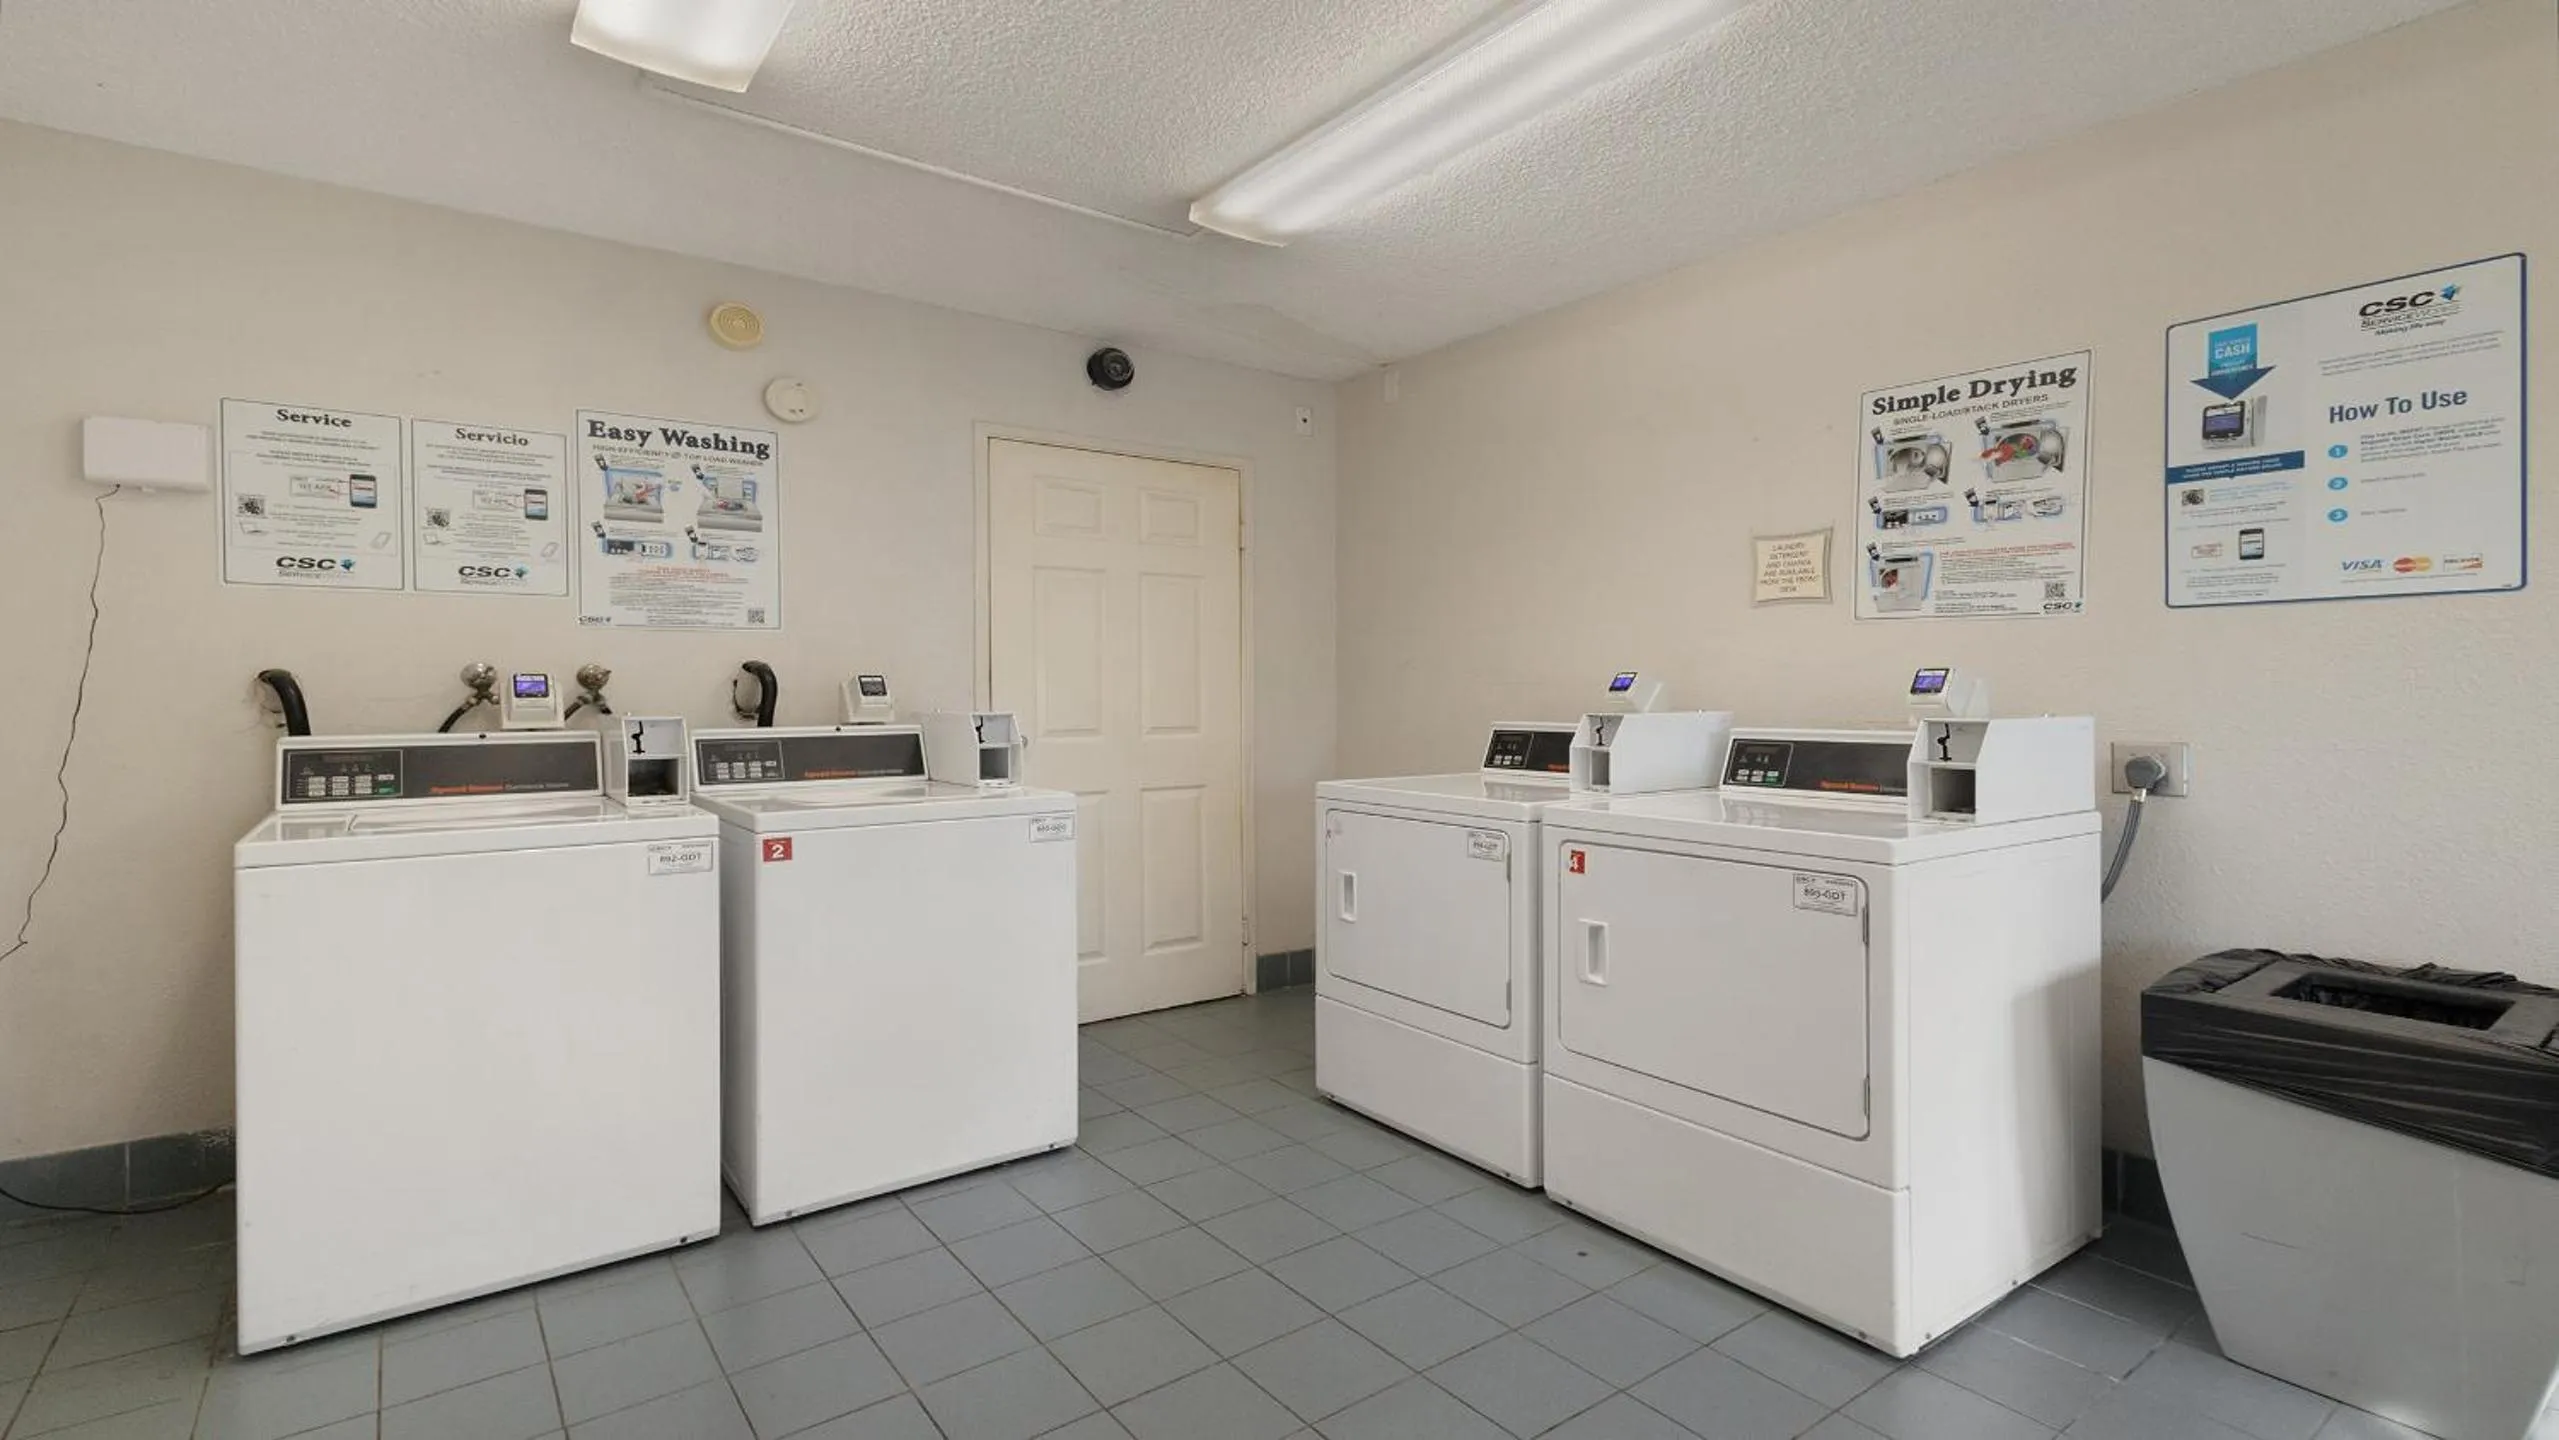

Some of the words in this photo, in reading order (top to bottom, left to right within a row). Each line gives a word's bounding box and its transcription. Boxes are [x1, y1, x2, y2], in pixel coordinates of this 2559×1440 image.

[2359, 291, 2436, 317] CSC
[2215, 343, 2250, 360] CASH
[1872, 385, 1961, 416] Simple
[1968, 366, 2078, 399] Drying
[2002, 394, 2049, 409] DRYERS
[2329, 404, 2379, 424] How
[2386, 396, 2412, 416] To
[2421, 390, 2468, 410] Use
[276, 408, 352, 428] Service
[455, 427, 529, 446] Servicio
[587, 419, 652, 447] Easy
[659, 427, 770, 460] Washing
[276, 556, 337, 570] CSC
[458, 566, 511, 578] CSC
[2341, 559, 2383, 571] VISA
[772, 844, 785, 859] 2
